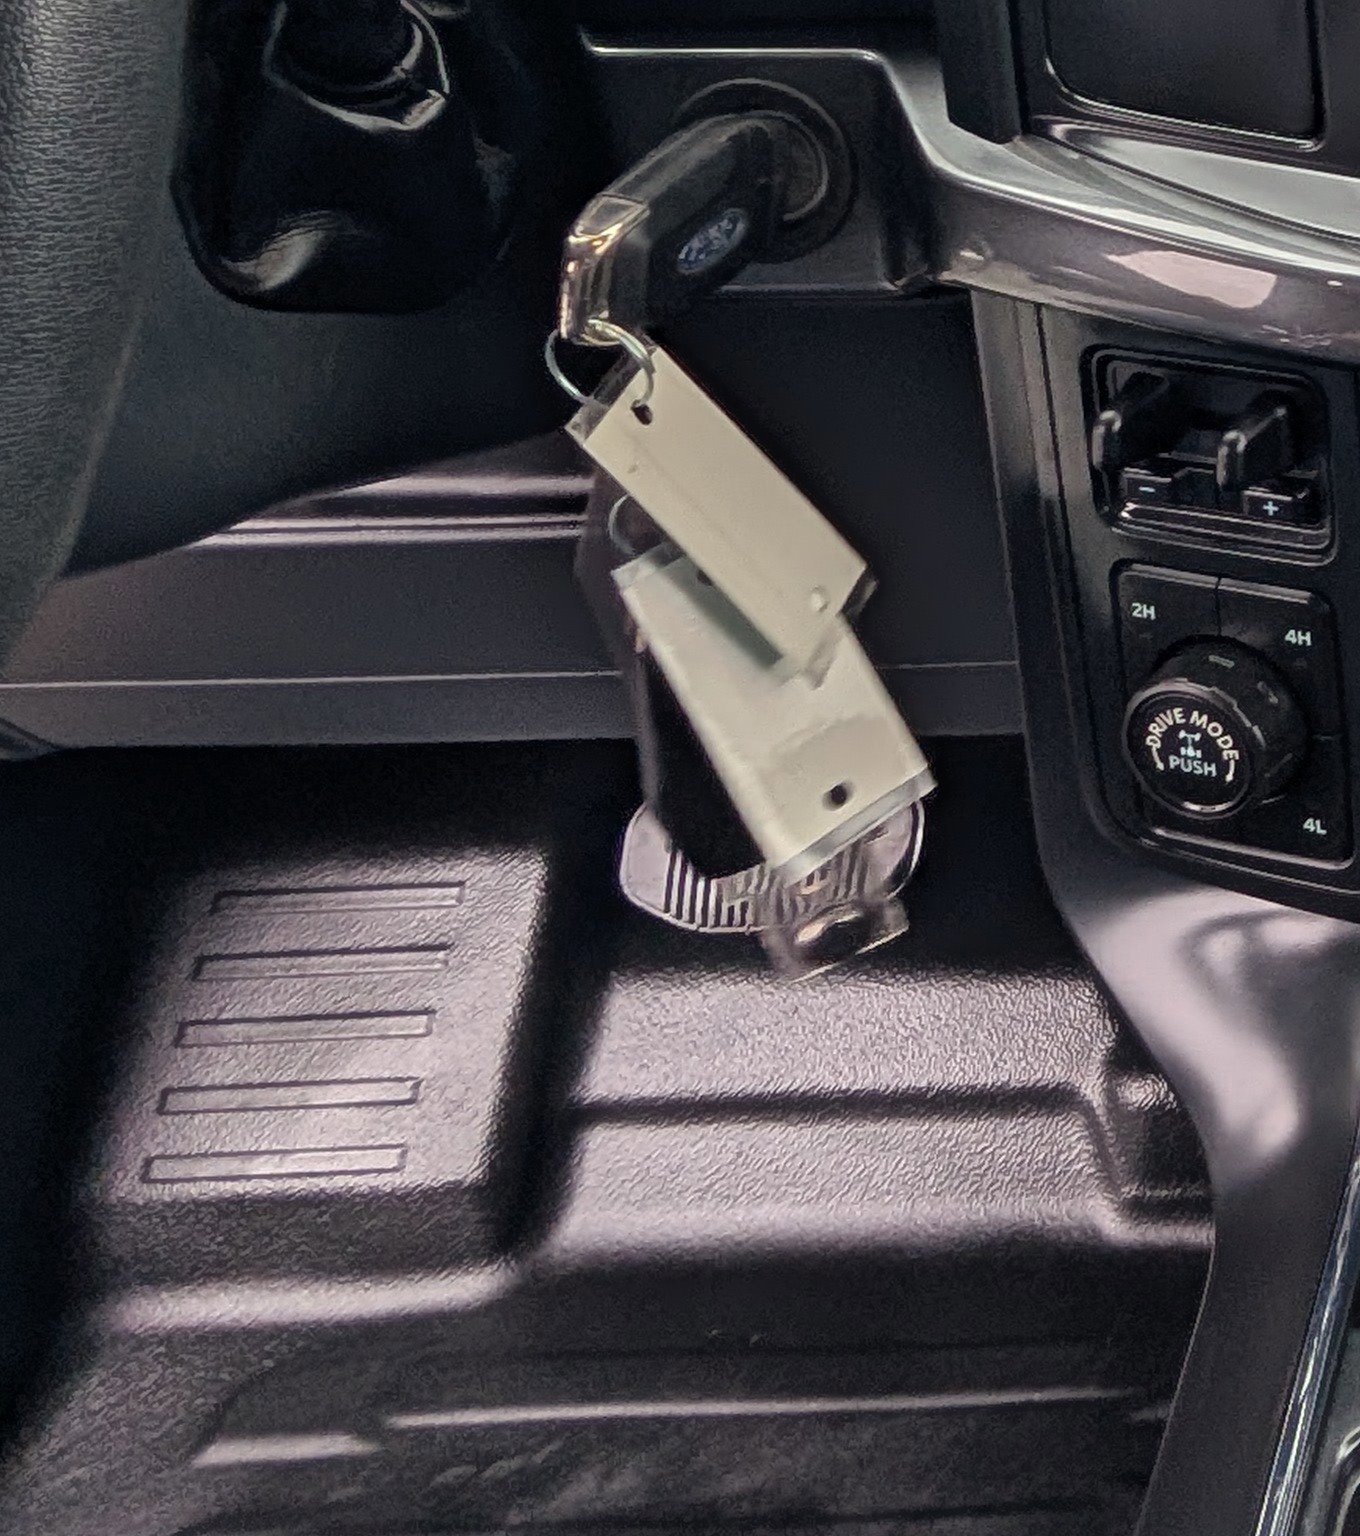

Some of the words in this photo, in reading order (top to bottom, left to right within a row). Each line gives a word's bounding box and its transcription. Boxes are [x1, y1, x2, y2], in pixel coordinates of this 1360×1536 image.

[1131, 602, 1156, 621] 2H
[1284, 629, 1312, 647] 4H
[1145, 707, 1187, 749] DRIVE
[1189, 710, 1240, 761] MODE
[1168, 755, 1217, 777] PUSH
[1303, 818, 1327, 835] 4L
